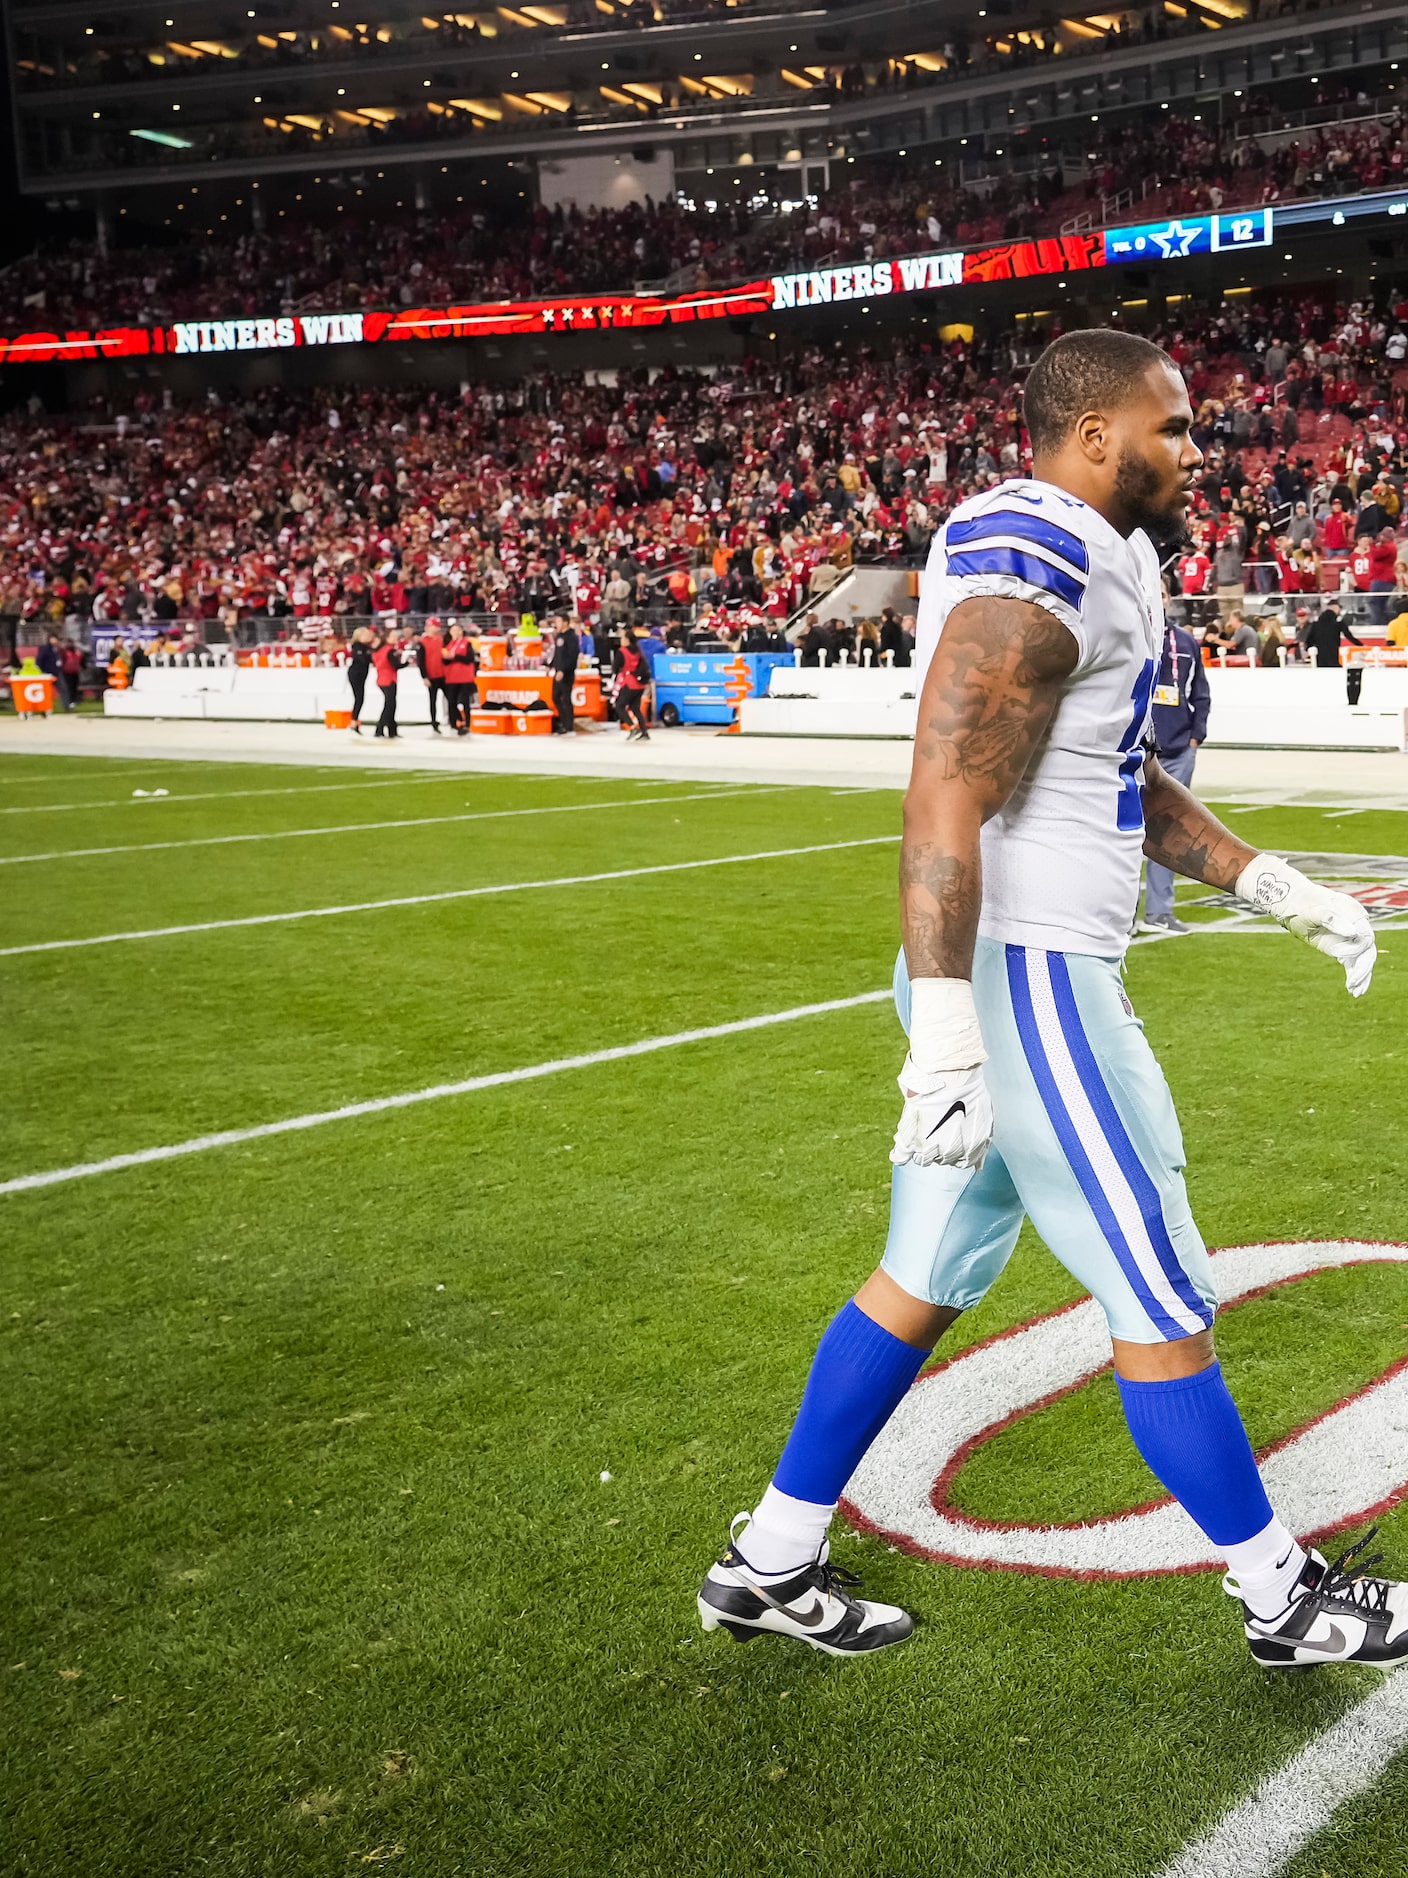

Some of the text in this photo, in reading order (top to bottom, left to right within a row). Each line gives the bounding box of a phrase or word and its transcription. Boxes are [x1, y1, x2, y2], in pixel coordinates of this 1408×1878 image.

[1332, 212, 1346, 225] &
[1134, 236, 1146, 250] 0
[1231, 220, 1253, 242] 12
[771, 252, 964, 310] NINERS WIN
[173, 313, 364, 353] NINERS WIN
[24, 683, 45, 703] G
[571, 687, 586, 707] G
